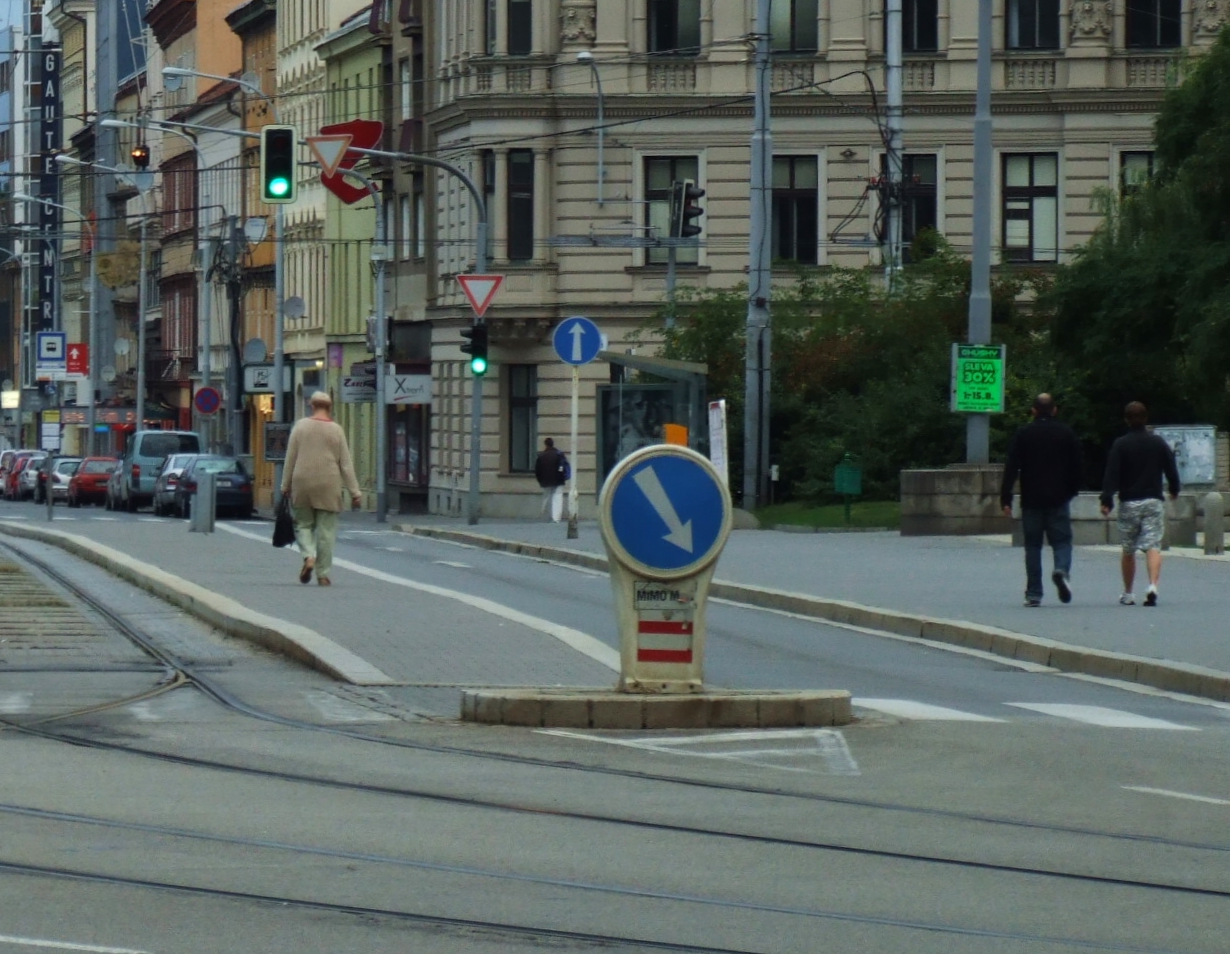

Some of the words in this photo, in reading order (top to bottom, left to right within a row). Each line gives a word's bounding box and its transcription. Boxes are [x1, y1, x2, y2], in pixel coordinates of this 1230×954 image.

[45, 54, 55, 174] GAUTE
[964, 362, 994, 371] SLEVA
[964, 372, 995, 383] 30%
